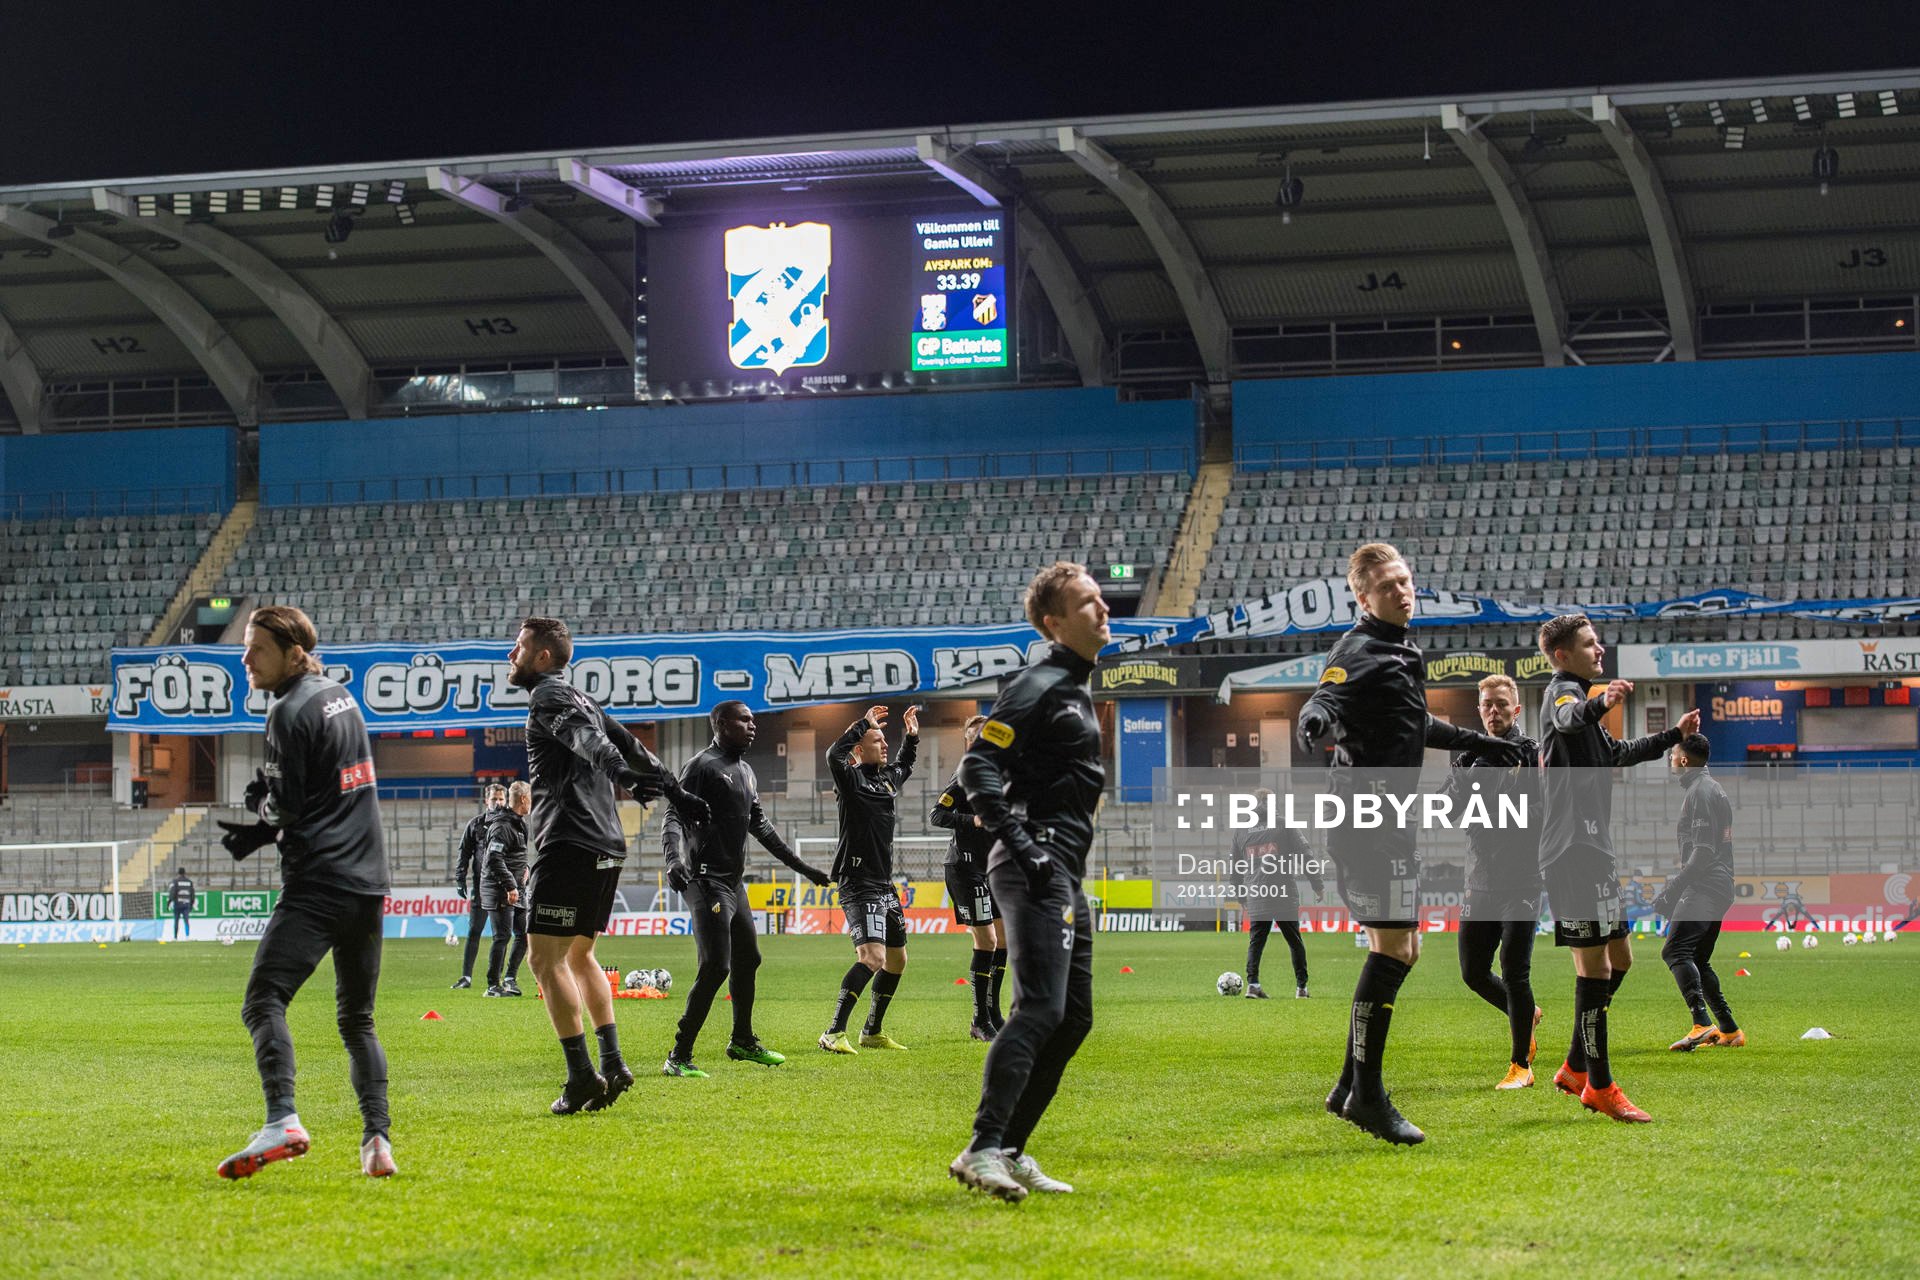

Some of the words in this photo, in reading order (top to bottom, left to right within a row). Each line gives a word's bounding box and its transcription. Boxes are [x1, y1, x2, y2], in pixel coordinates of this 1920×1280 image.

[916, 222, 982, 235] Välkommen
[983, 219, 1000, 231] till
[924, 237, 960, 250] Gamla
[961, 235, 993, 248] Ullevi
[924, 259, 972, 272] AVSPARK
[973, 257, 993, 268] OM:
[1838, 247, 1888, 268] J3
[936, 272, 981, 291] 33.39
[1357, 272, 1407, 292] J4
[464, 317, 520, 337] H3
[91, 336, 146, 355] H2
[917, 337, 940, 356] GP
[802, 374, 847, 385] SAMSUNG
[181, 627, 195, 645] H2
[1671, 648, 1721, 668] Idre
[1725, 647, 1781, 669] Fjäll
[1102, 664, 1177, 688] KOPPARBERG
[1427, 655, 1505, 681] KOPPARBERG
[115, 655, 233, 717] FÖR
[365, 654, 701, 713] GÖTEORG
[764, 650, 921, 703] MED
[1712, 697, 1783, 721] Sofiero
[1584, 820, 1598, 835] 16
[852, 857, 862, 867] 17
[963, 852, 972, 862] 11
[700, 863, 708, 874] 5
[1391, 859, 1407, 876] 15
[974, 886, 984, 897] 11
[1596, 882, 1611, 898] 16
[229, 896, 262, 911] MCR
[866, 903, 877, 913] 17
